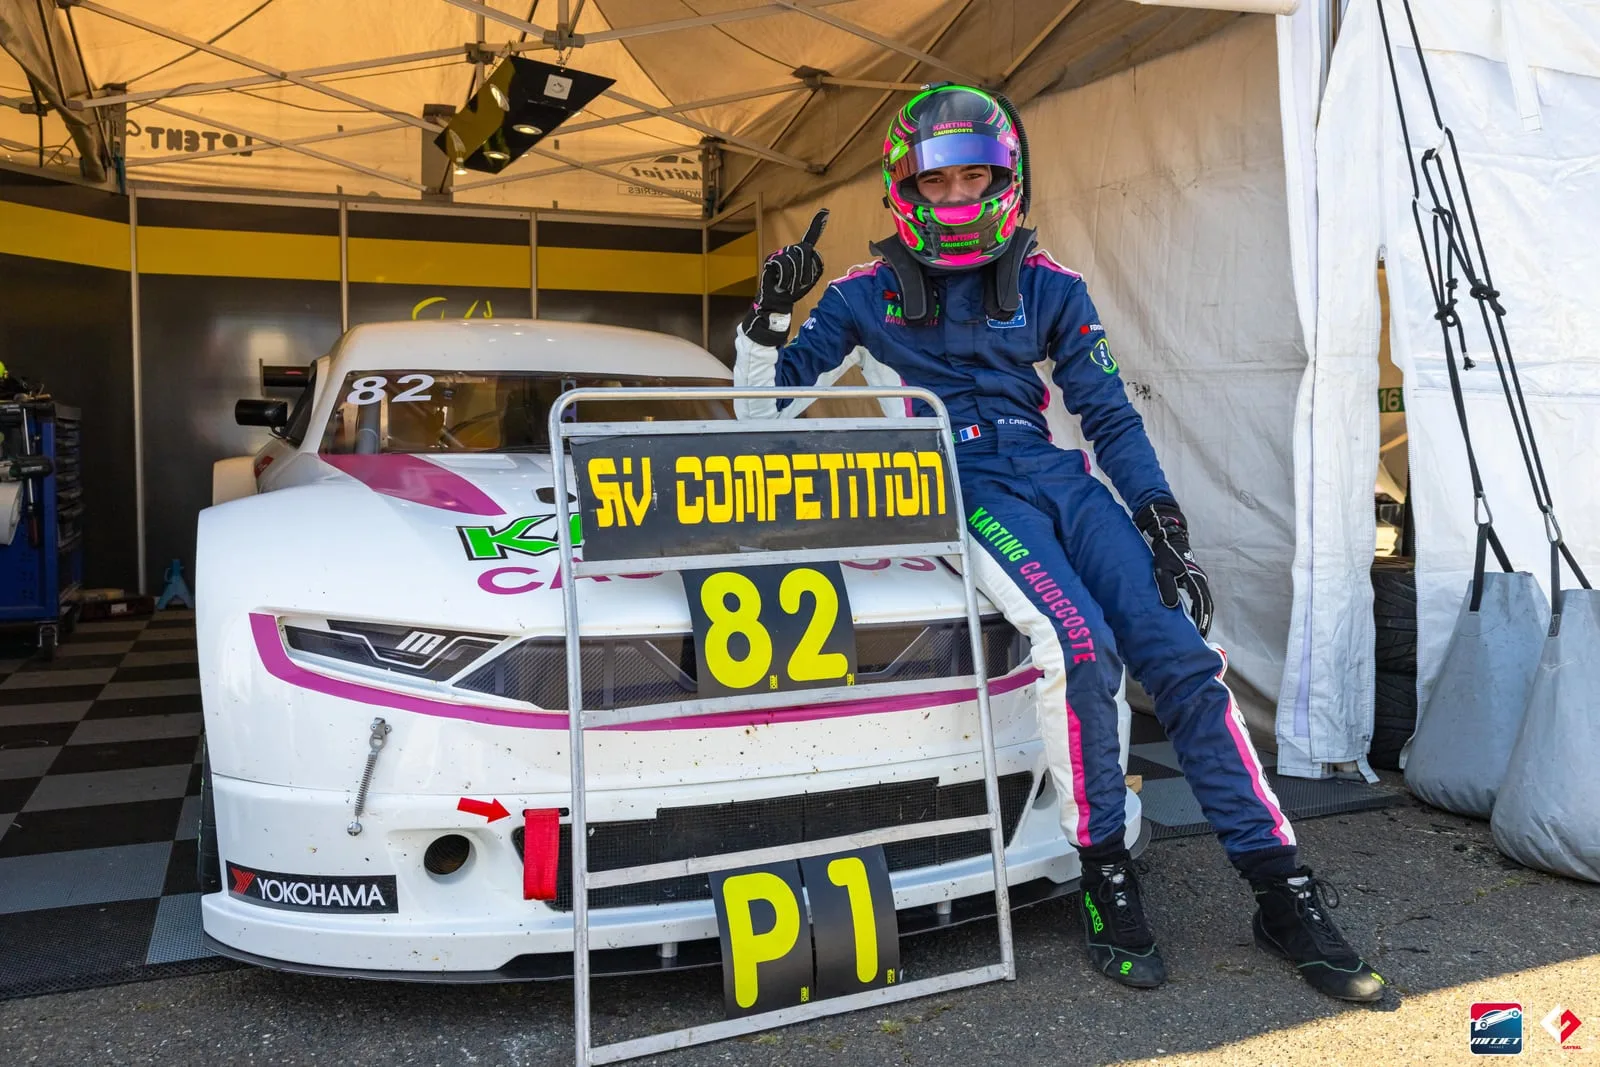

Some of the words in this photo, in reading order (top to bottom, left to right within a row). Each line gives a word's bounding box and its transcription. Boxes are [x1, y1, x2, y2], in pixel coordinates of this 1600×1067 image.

[346, 373, 436, 406] 82
[1380, 388, 1401, 411] 16
[675, 450, 947, 525] COMPETITION
[968, 506, 1031, 562] KARTING
[1019, 560, 1096, 664] CAUDECOSTE
[700, 567, 849, 689] 82
[256, 877, 386, 907] YOKOHAMA
